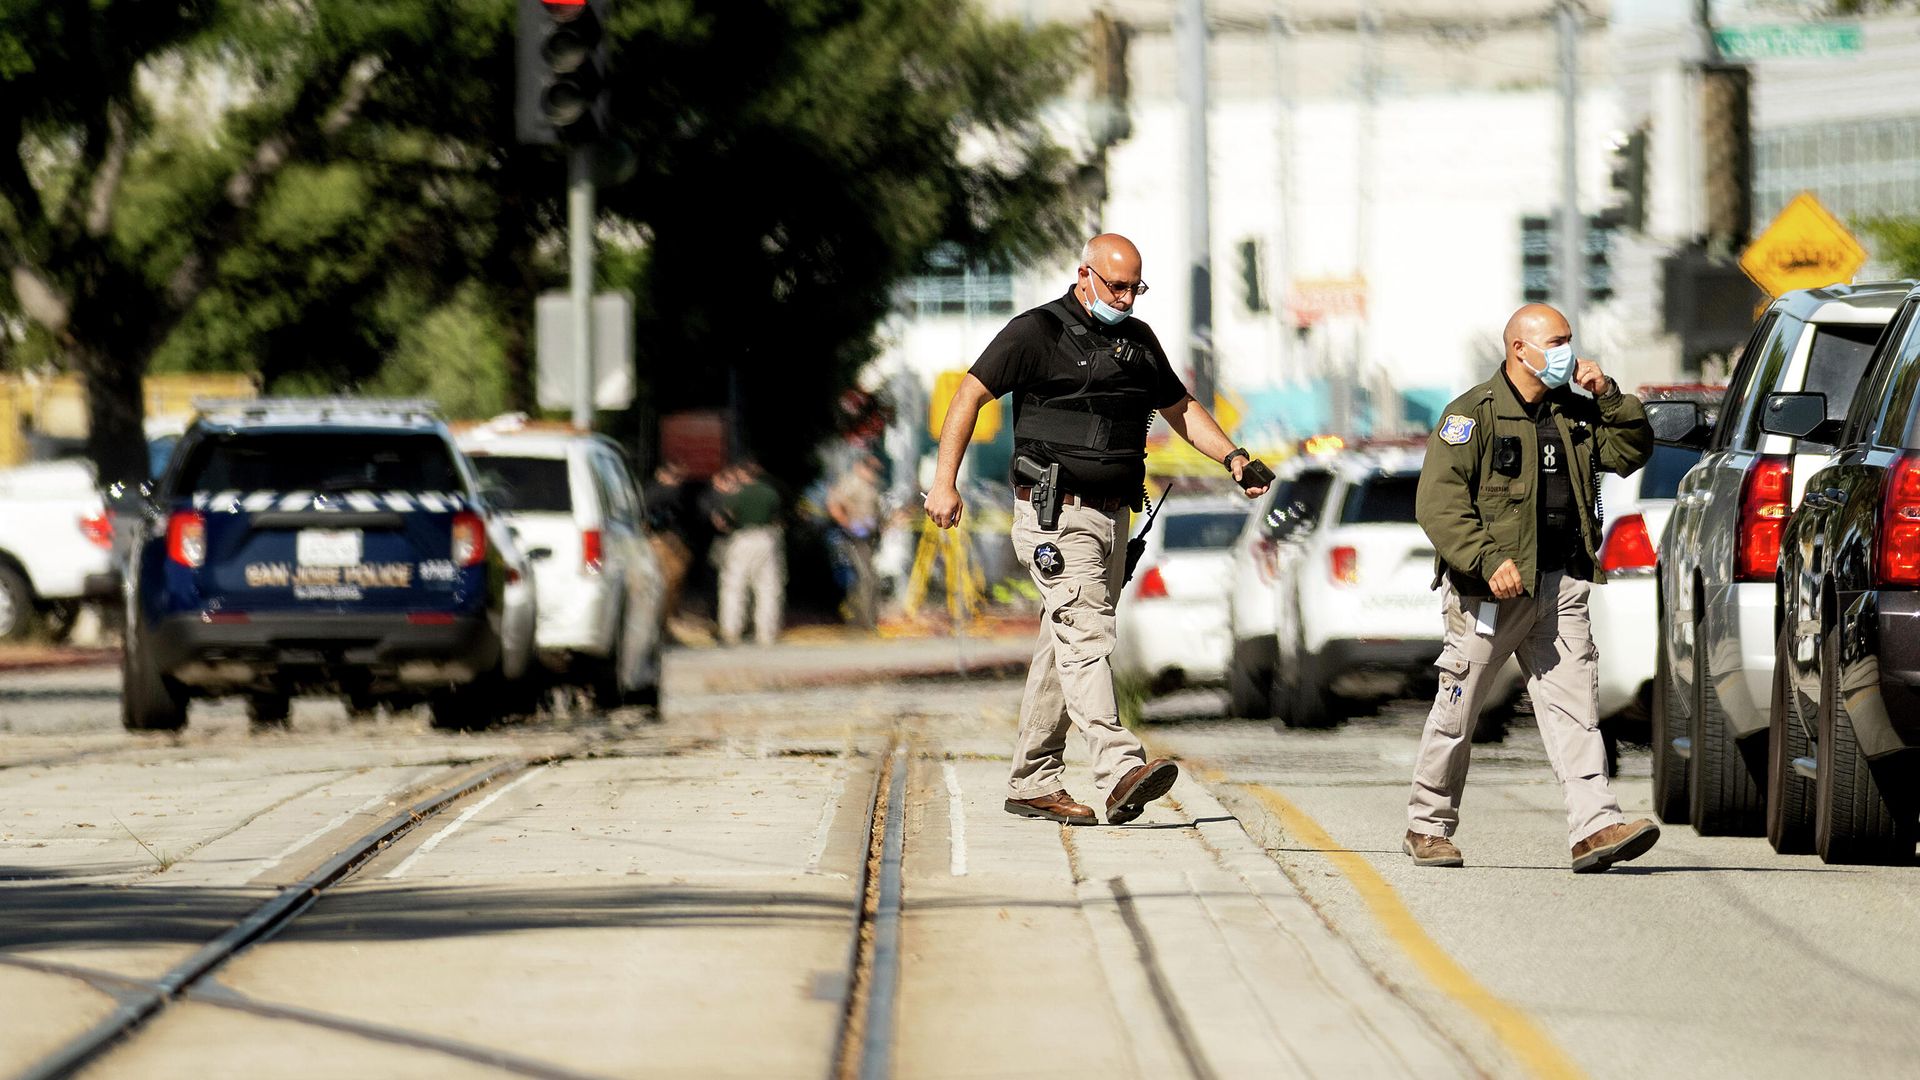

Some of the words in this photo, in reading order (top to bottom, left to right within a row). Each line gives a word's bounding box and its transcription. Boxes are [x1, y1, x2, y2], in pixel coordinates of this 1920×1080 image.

[245, 563, 290, 587] SAN
[292, 566, 341, 586] JOSE
[344, 563, 412, 588] POLICE
